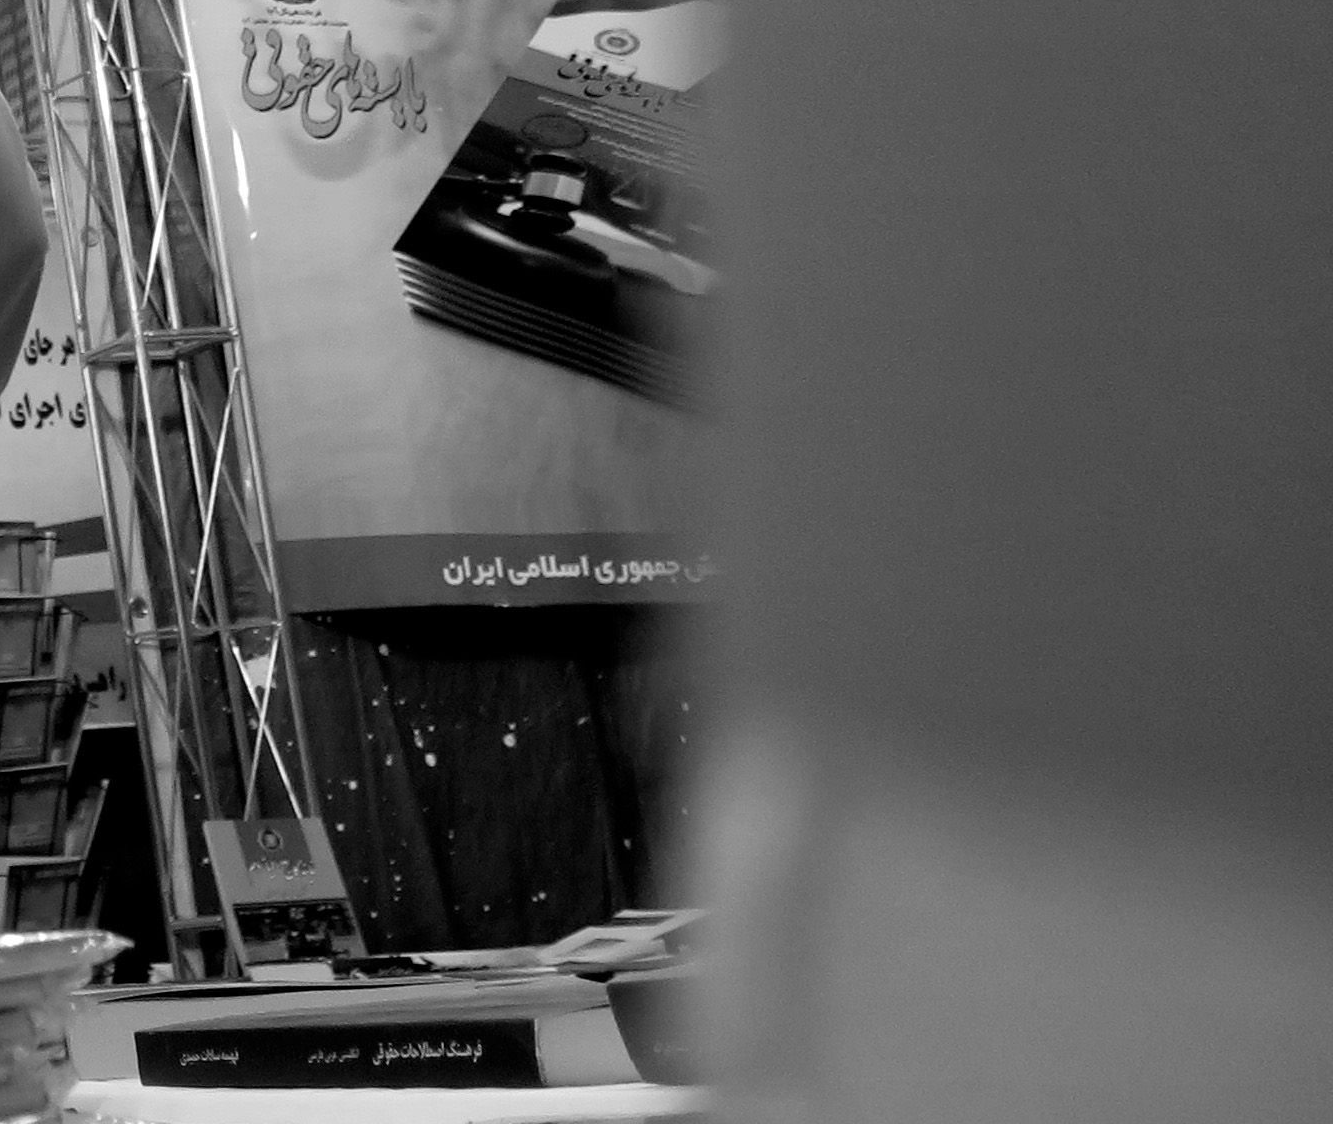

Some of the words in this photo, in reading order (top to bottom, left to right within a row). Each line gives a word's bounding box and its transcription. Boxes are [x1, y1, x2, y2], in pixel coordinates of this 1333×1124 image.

[8, 392, 64, 429] اجرای
[442, 555, 504, 586] ایران
[506, 554, 590, 586] اسلامی
[593, 559, 680, 584] جمهوری
[445, 1039, 483, 1064] فرهنگ
